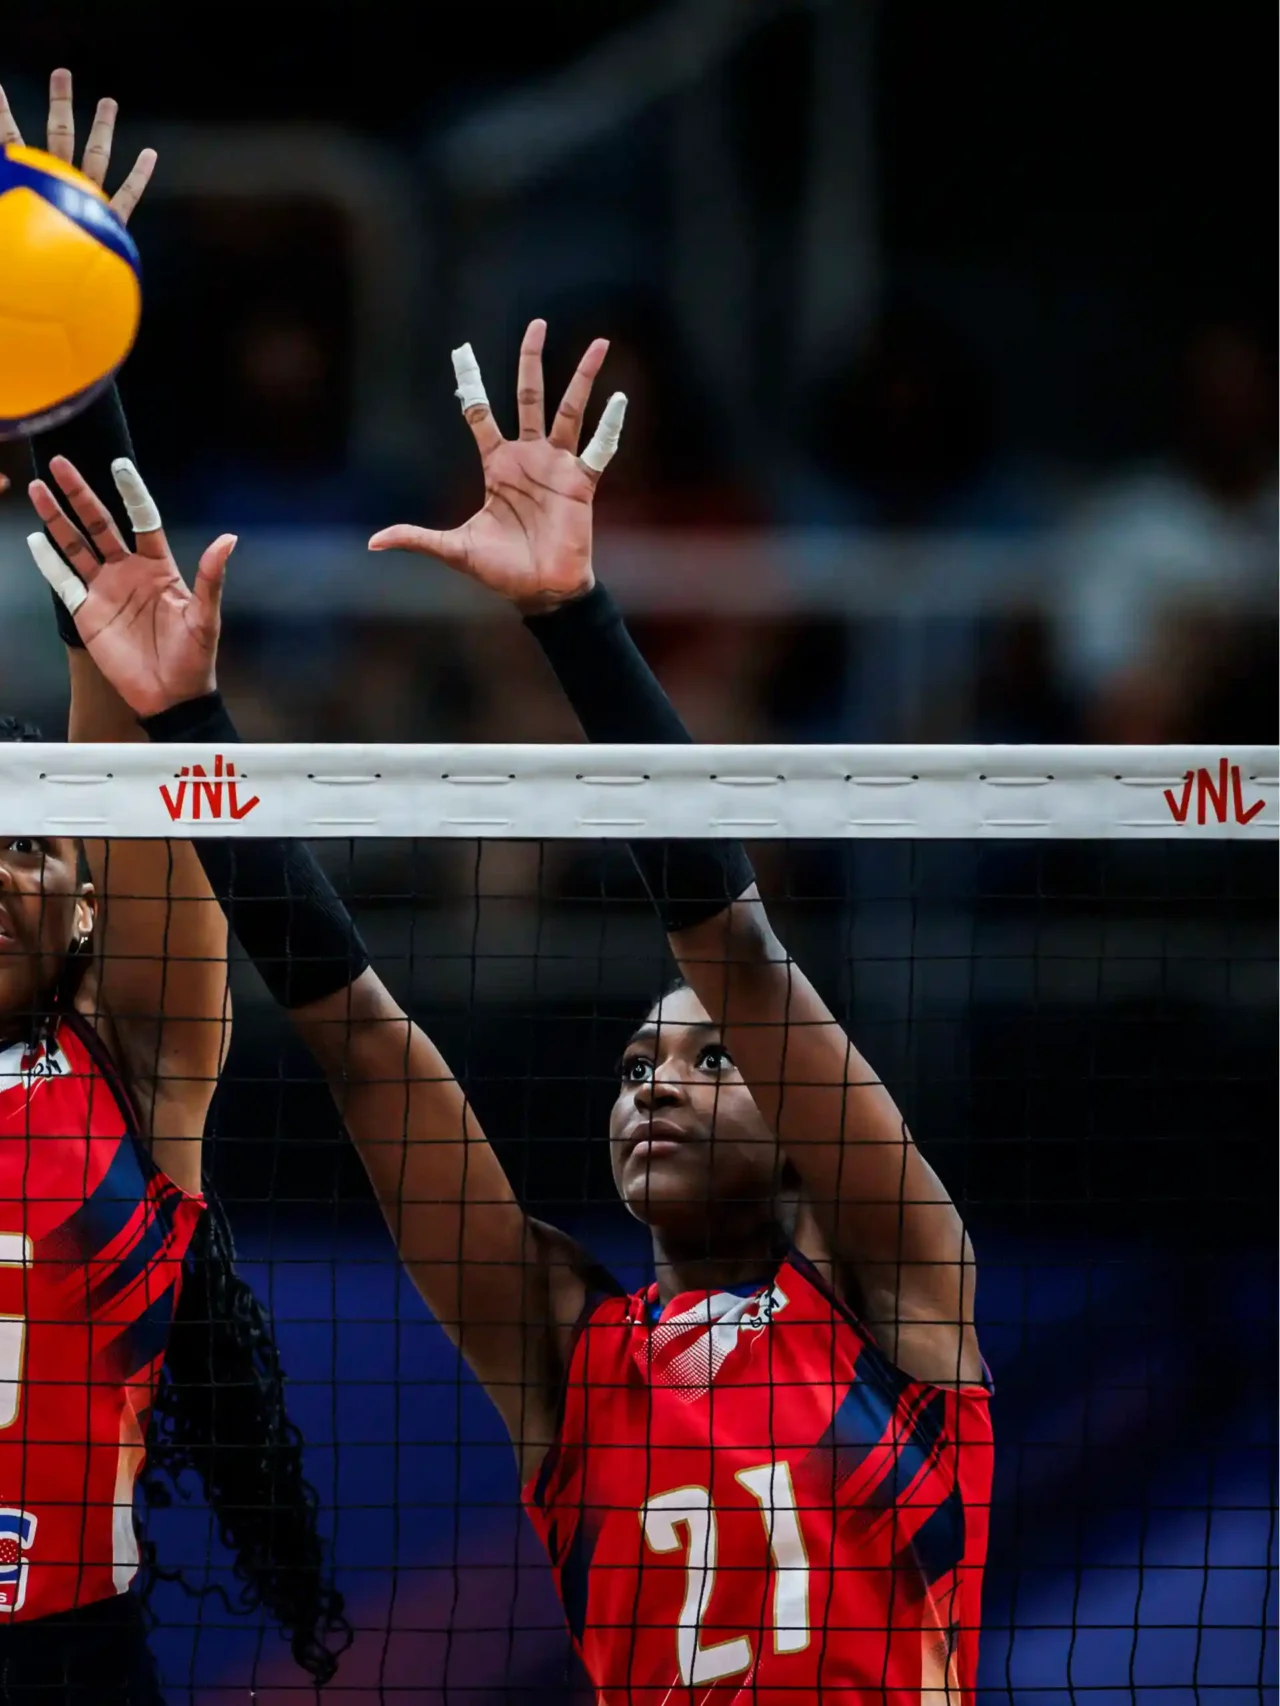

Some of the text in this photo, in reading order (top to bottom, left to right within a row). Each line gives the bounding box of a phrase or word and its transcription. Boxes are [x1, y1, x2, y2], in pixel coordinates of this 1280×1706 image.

[159, 754, 260, 821] VNL
[1163, 757, 1266, 825] VNL
[638, 1461, 811, 1686] 21
